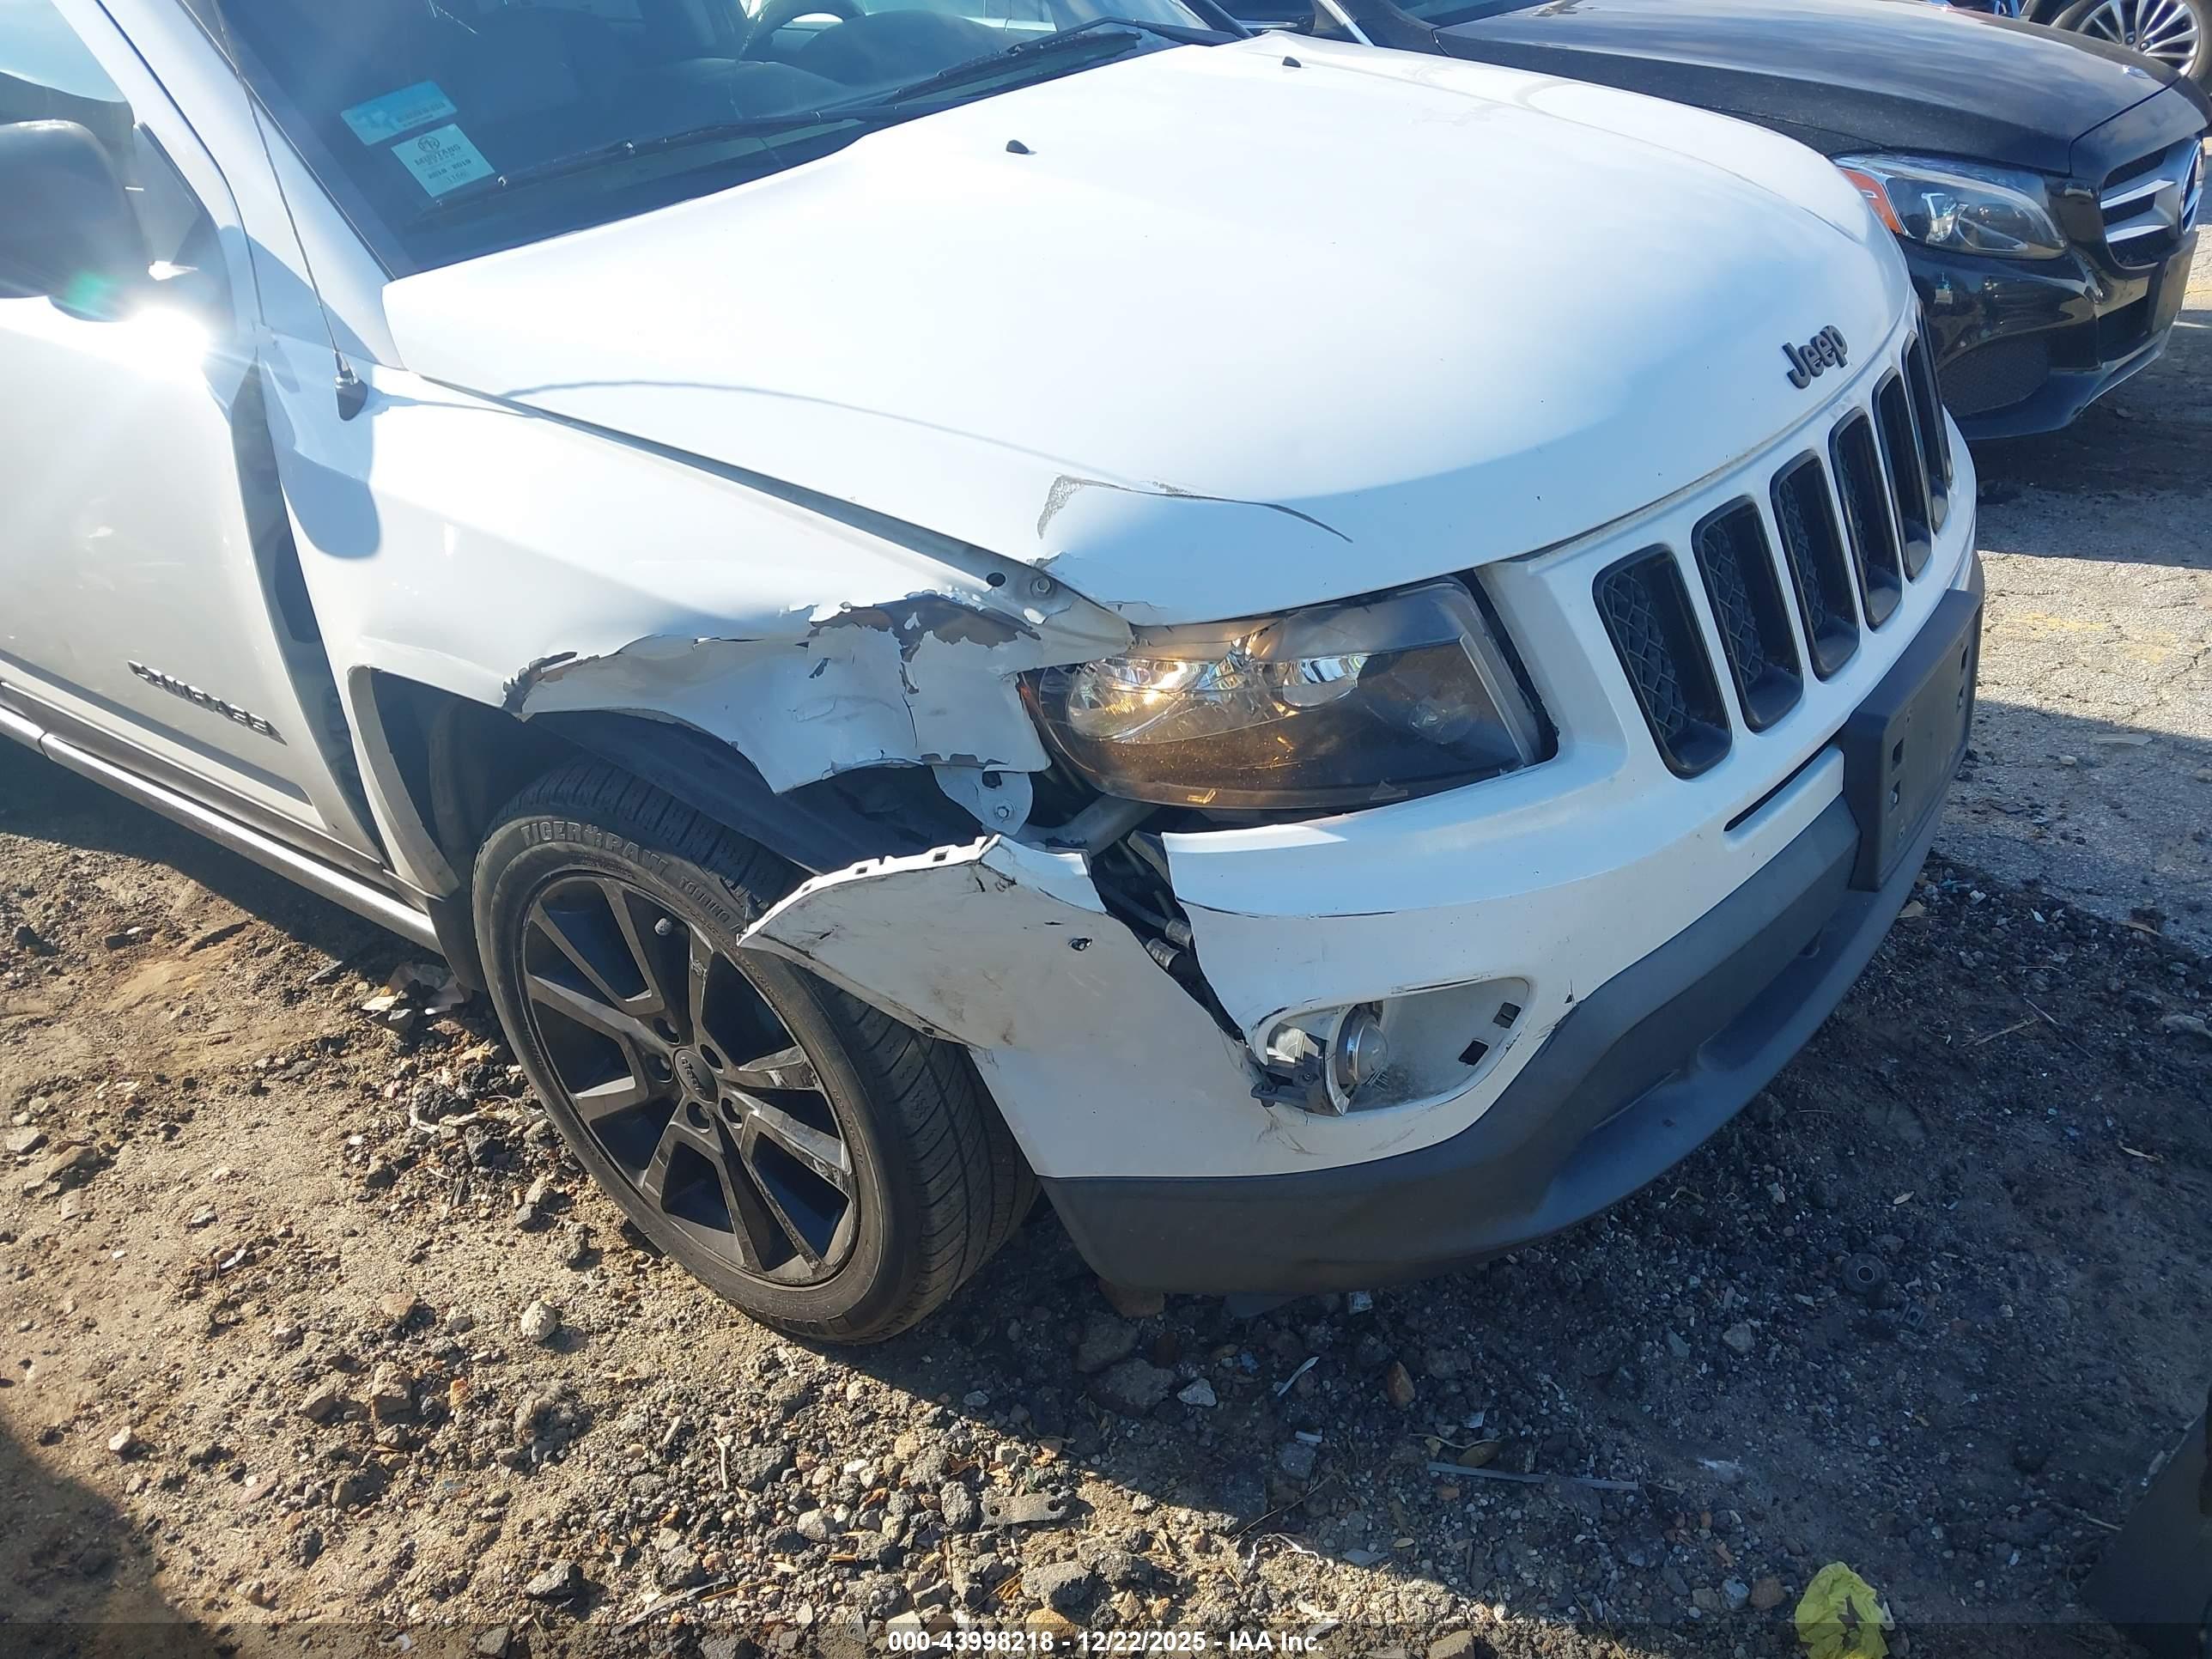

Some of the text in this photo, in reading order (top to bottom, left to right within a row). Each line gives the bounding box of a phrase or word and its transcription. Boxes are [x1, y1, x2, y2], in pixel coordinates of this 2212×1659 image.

[1782, 325, 1848, 389] Jeep
[127, 659, 289, 745] COMPASS
[520, 821, 582, 847] TIGER
[605, 831, 671, 874] PAW
